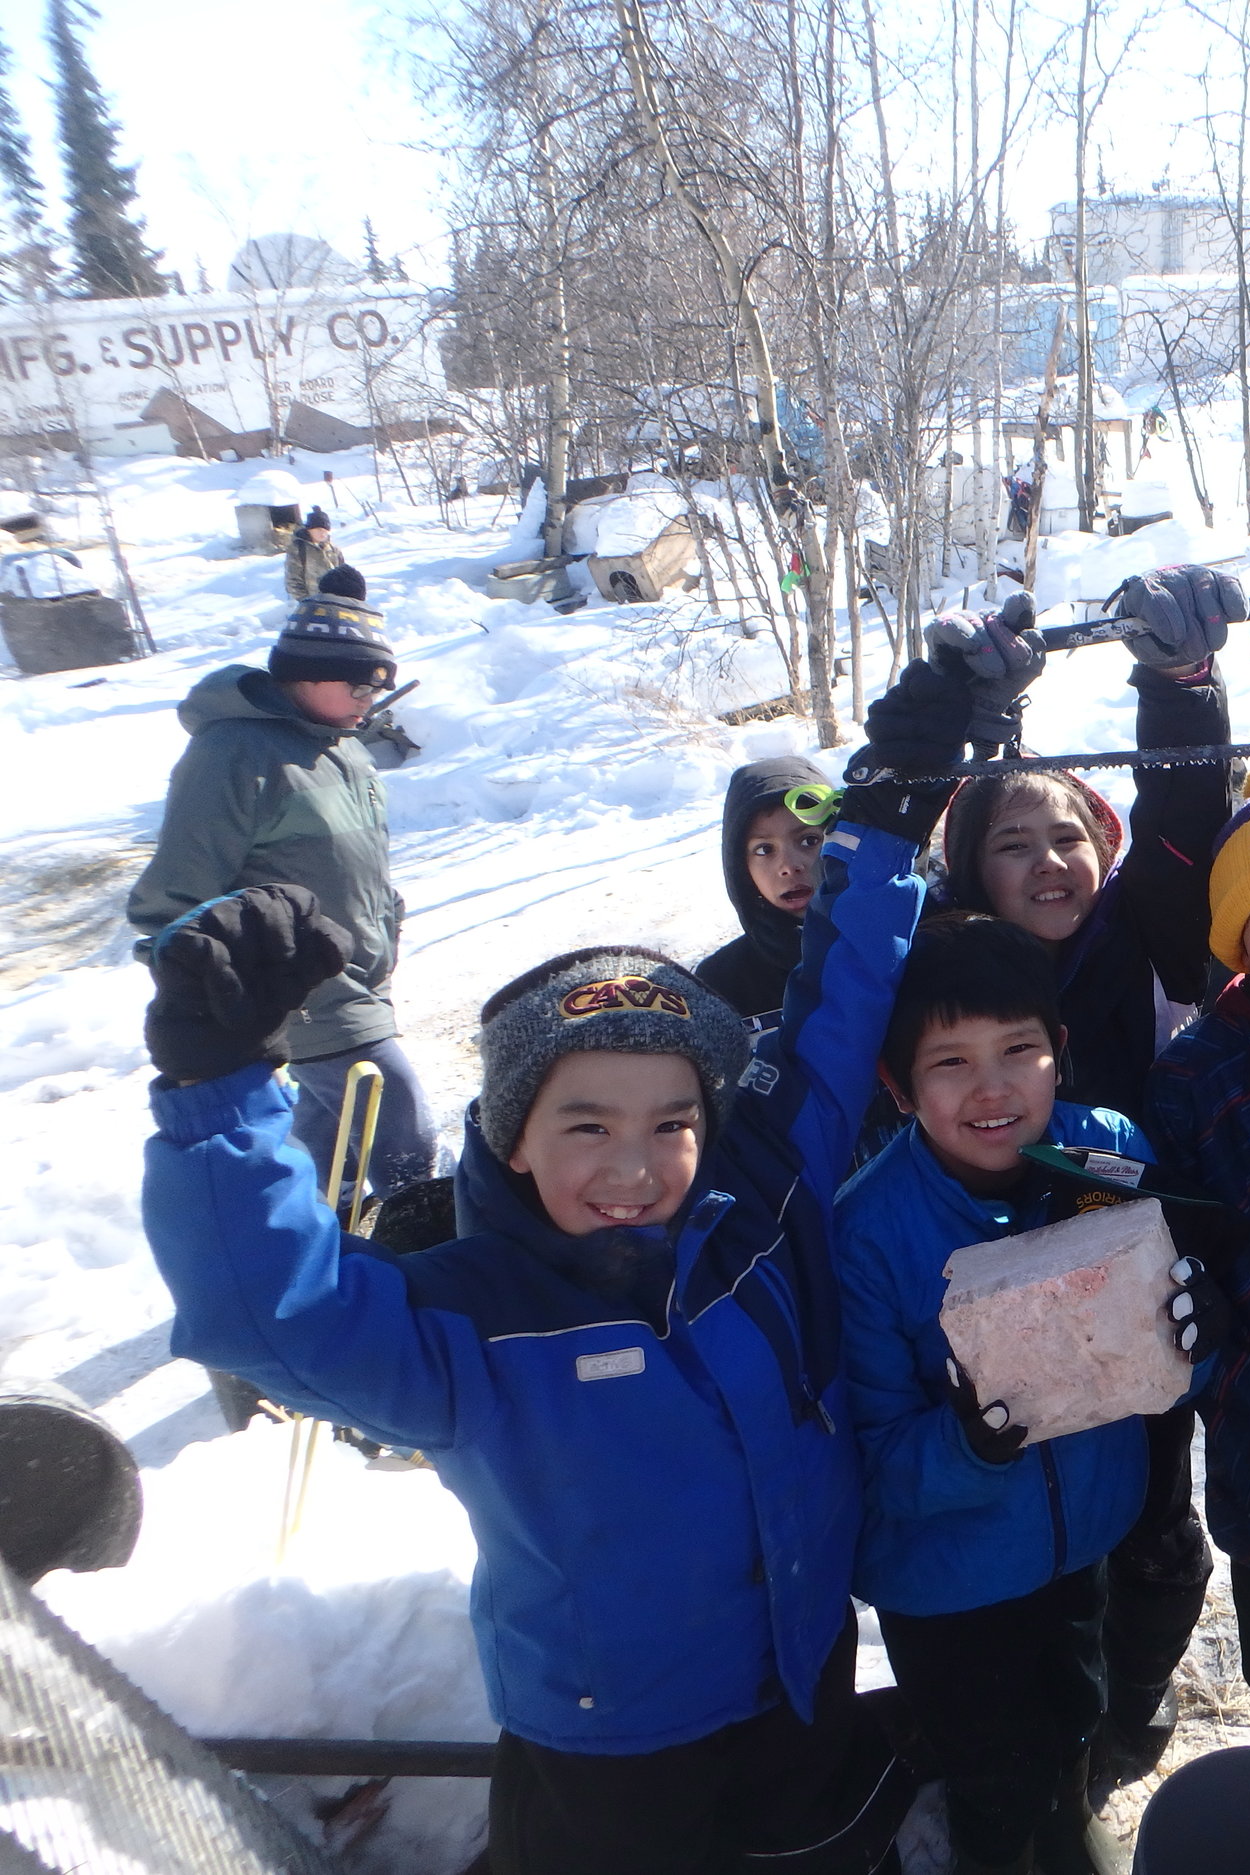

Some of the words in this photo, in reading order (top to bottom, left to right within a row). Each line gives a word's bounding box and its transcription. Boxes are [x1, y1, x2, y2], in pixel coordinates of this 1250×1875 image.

[123, 315, 296, 370] SUPPLY
[327, 308, 402, 351] CO.
[564, 982, 687, 1016] CAVS
